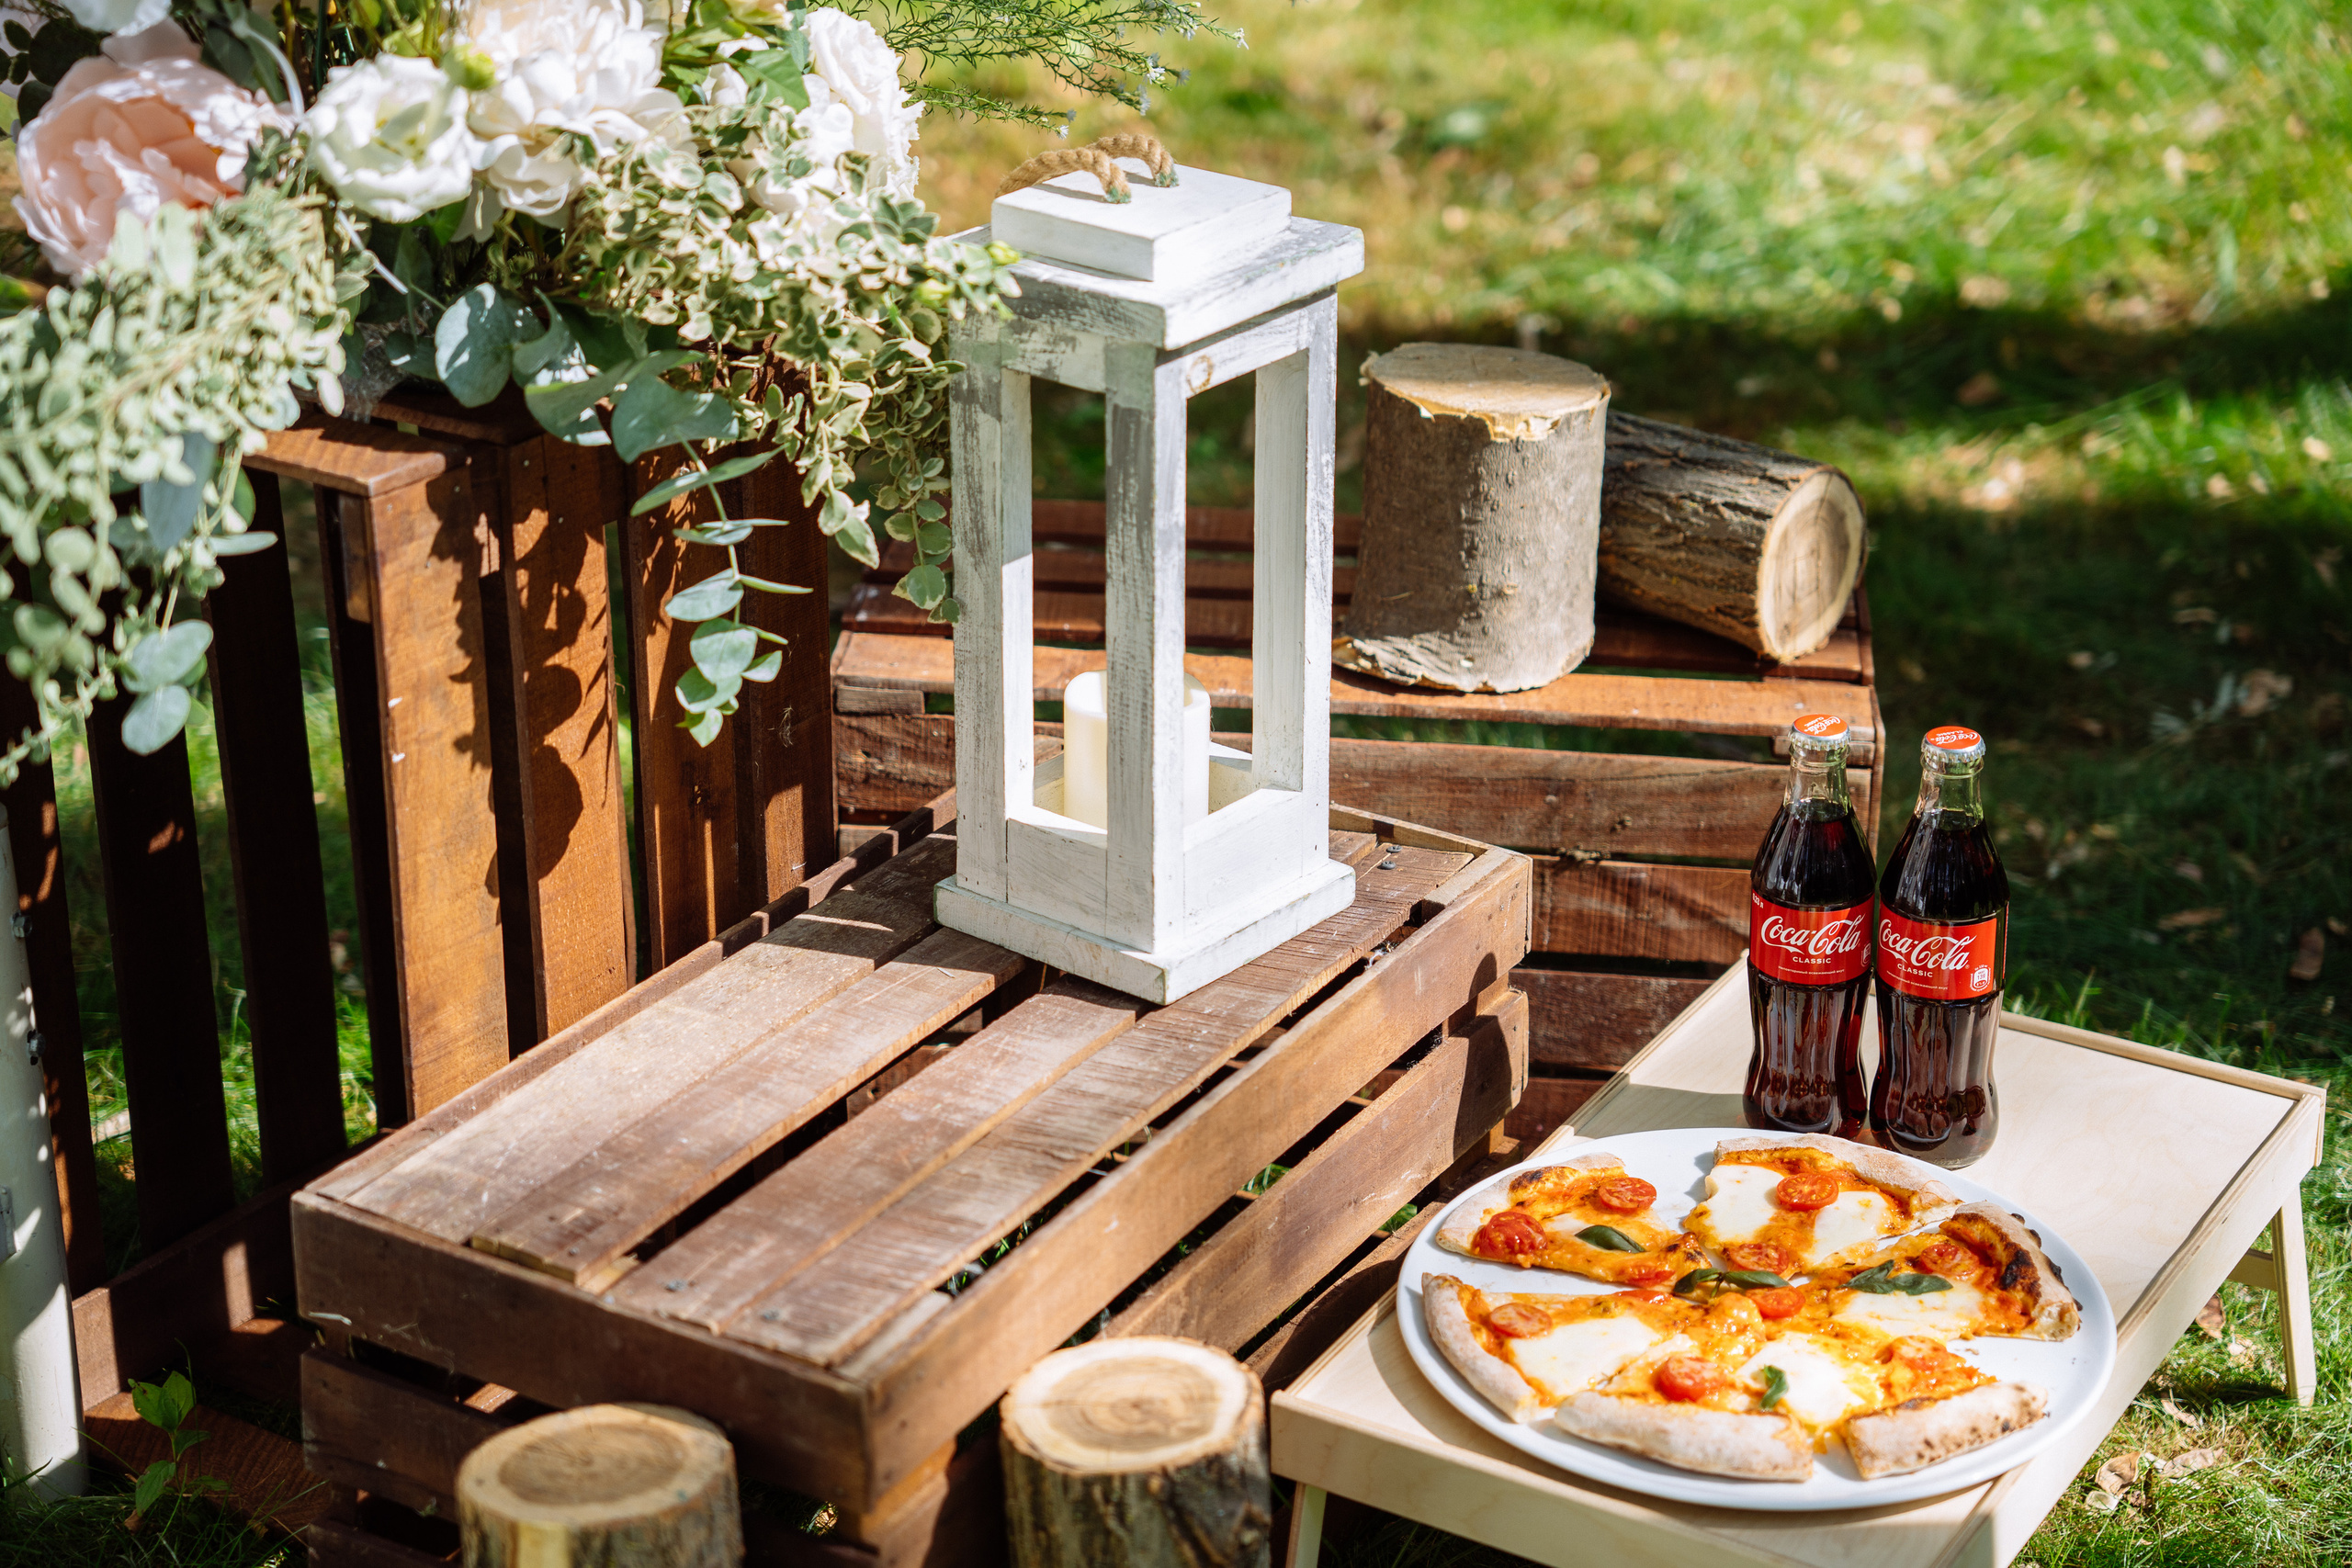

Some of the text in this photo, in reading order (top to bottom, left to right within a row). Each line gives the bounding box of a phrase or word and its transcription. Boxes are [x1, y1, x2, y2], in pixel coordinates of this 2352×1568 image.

[1807, 716, 1841, 735] Coca-Cola
[1935, 731, 1978, 745] Coca-Cola
[1761, 913, 1866, 956] Coca-Cola
[1879, 919, 1977, 970] Coca-Cola
[1897, 964, 1933, 977] CLASSIC
